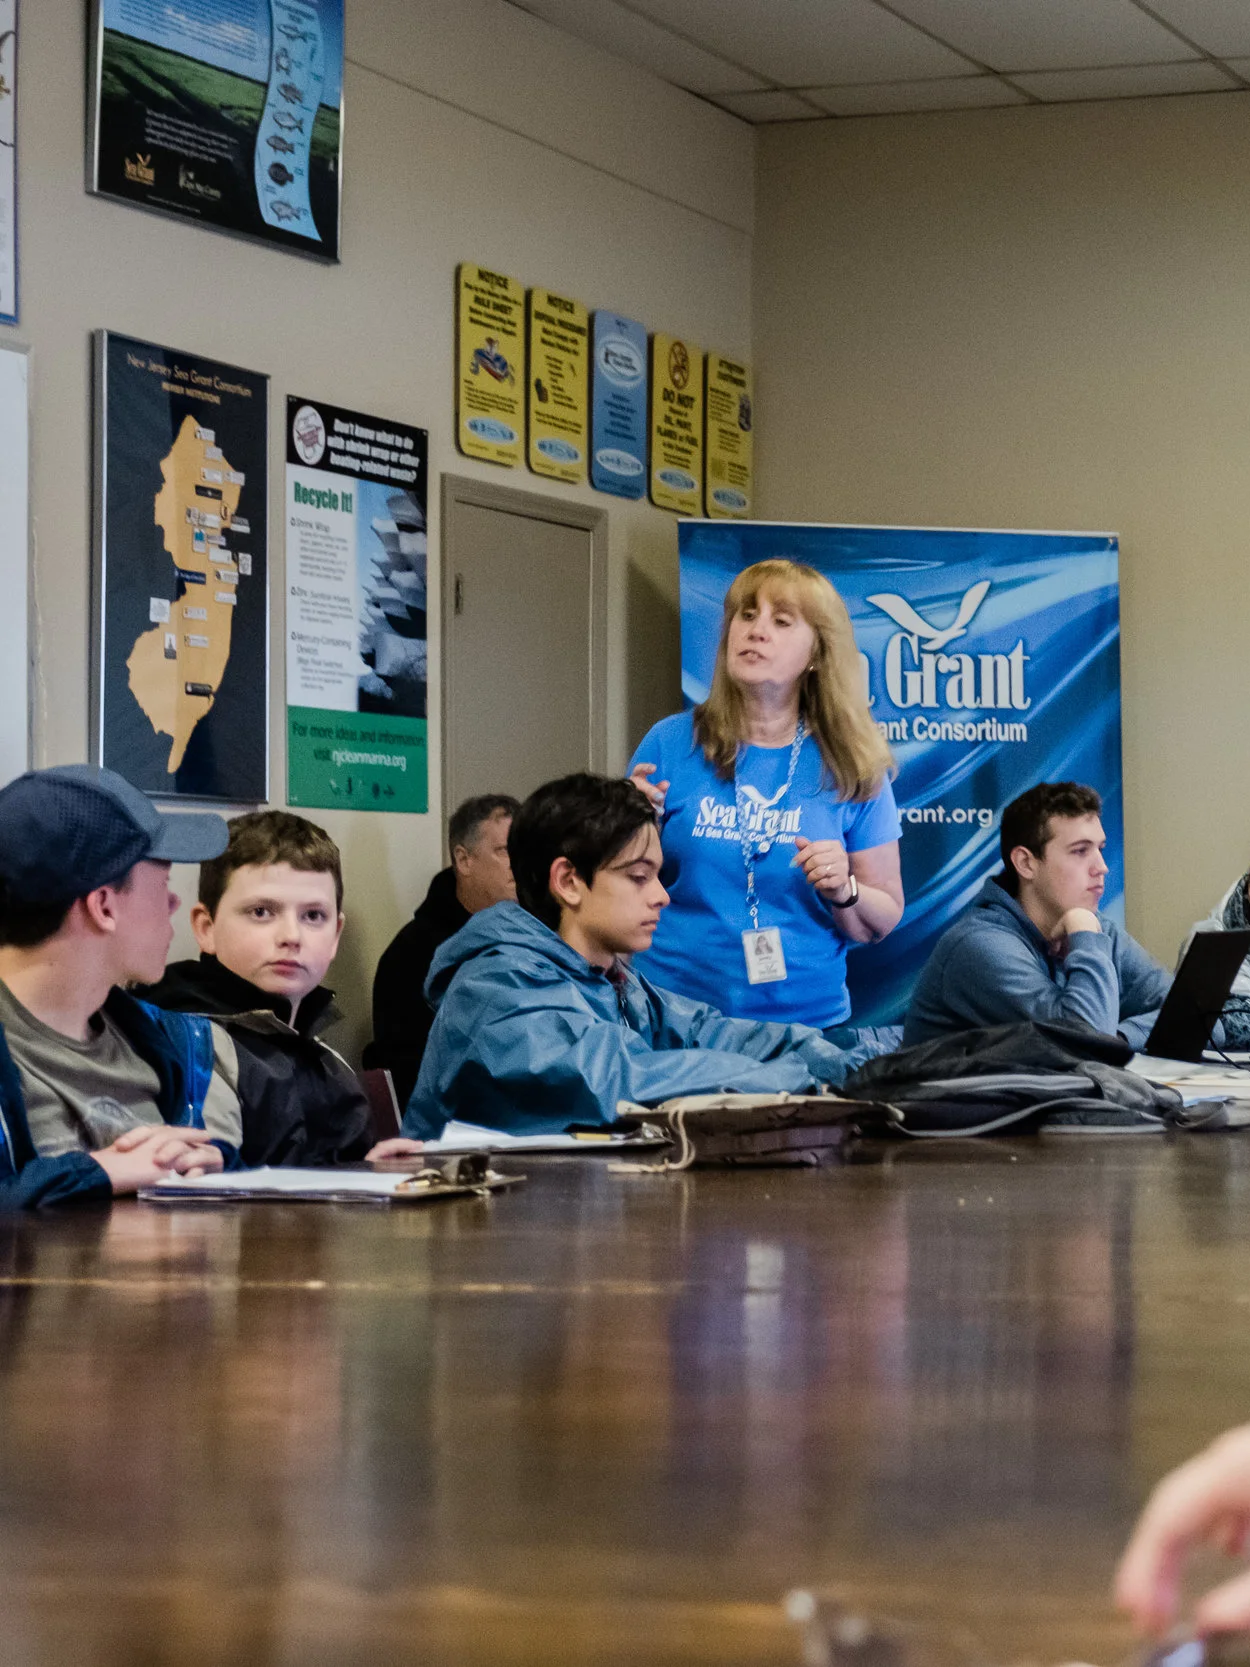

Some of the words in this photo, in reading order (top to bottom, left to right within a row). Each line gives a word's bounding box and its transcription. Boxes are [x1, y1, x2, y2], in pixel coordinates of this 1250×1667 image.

[478, 268, 509, 290] NOTICE
[126, 352, 145, 368] New
[147, 356, 172, 379] Jersey
[173, 364, 189, 381] Sea
[190, 369, 212, 387] Grant
[213, 374, 253, 399] Consortium
[663, 387, 676, 404] DO
[677, 392, 695, 410] NOT
[333, 418, 355, 436] Don't
[355, 423, 376, 440] know
[375, 430, 395, 446] what
[395, 435, 403, 448] to
[403, 436, 414, 450] do
[327, 435, 345, 451] with
[345, 439, 371, 457] shrink
[371, 446, 390, 462] wrap
[390, 451, 399, 463] or
[399, 453, 420, 468] other
[390, 466, 417, 484] waste?
[294, 480, 339, 511] Recycle
[341, 490, 353, 514] It!
[885, 632, 1032, 710] Grant
[292, 720, 308, 737] For
[310, 726, 333, 739] more
[335, 724, 357, 742] ideas
[360, 730, 377, 743] and
[378, 731, 424, 747] information
[877, 717, 909, 741] ant
[913, 715, 1028, 743] Consortium
[332, 749, 407, 772] njcleanmarina.org
[695, 796, 738, 828] Sea
[744, 800, 803, 833] Grant
[898, 804, 993, 828] rant.org
[691, 826, 705, 838] NJ
[705, 826, 722, 839] Sea
